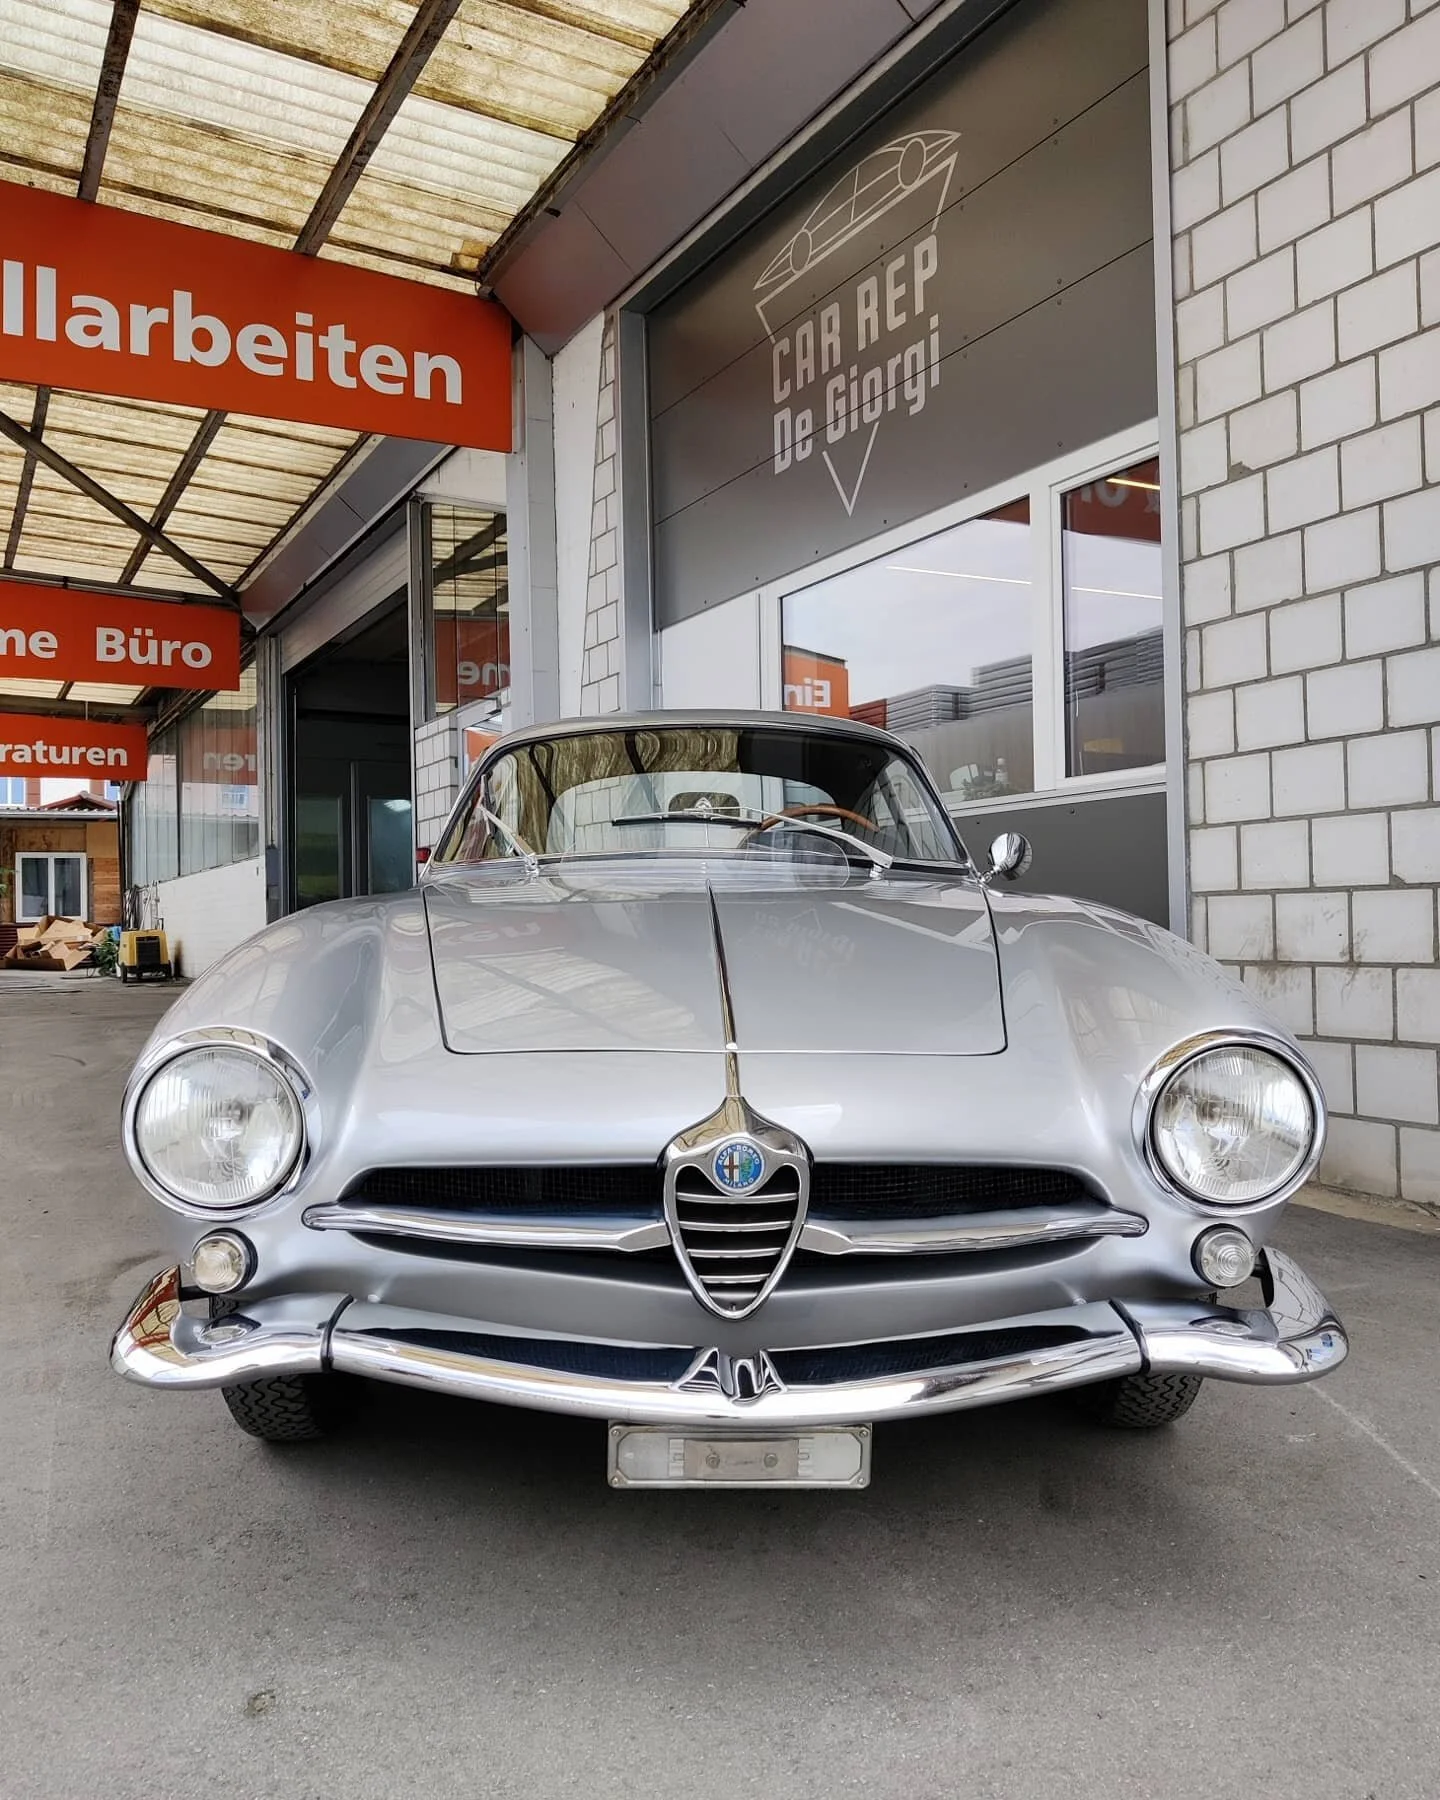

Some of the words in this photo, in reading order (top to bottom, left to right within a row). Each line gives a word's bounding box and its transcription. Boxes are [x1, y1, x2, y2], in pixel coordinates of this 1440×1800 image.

[3, 259, 463, 405] llarbeiten
[773, 302, 841, 404] CAR
[857, 234, 937, 352] REP
[774, 407, 813, 475] De
[826, 314, 940, 444] Giorgi
[96, 627, 212, 669] Büro
